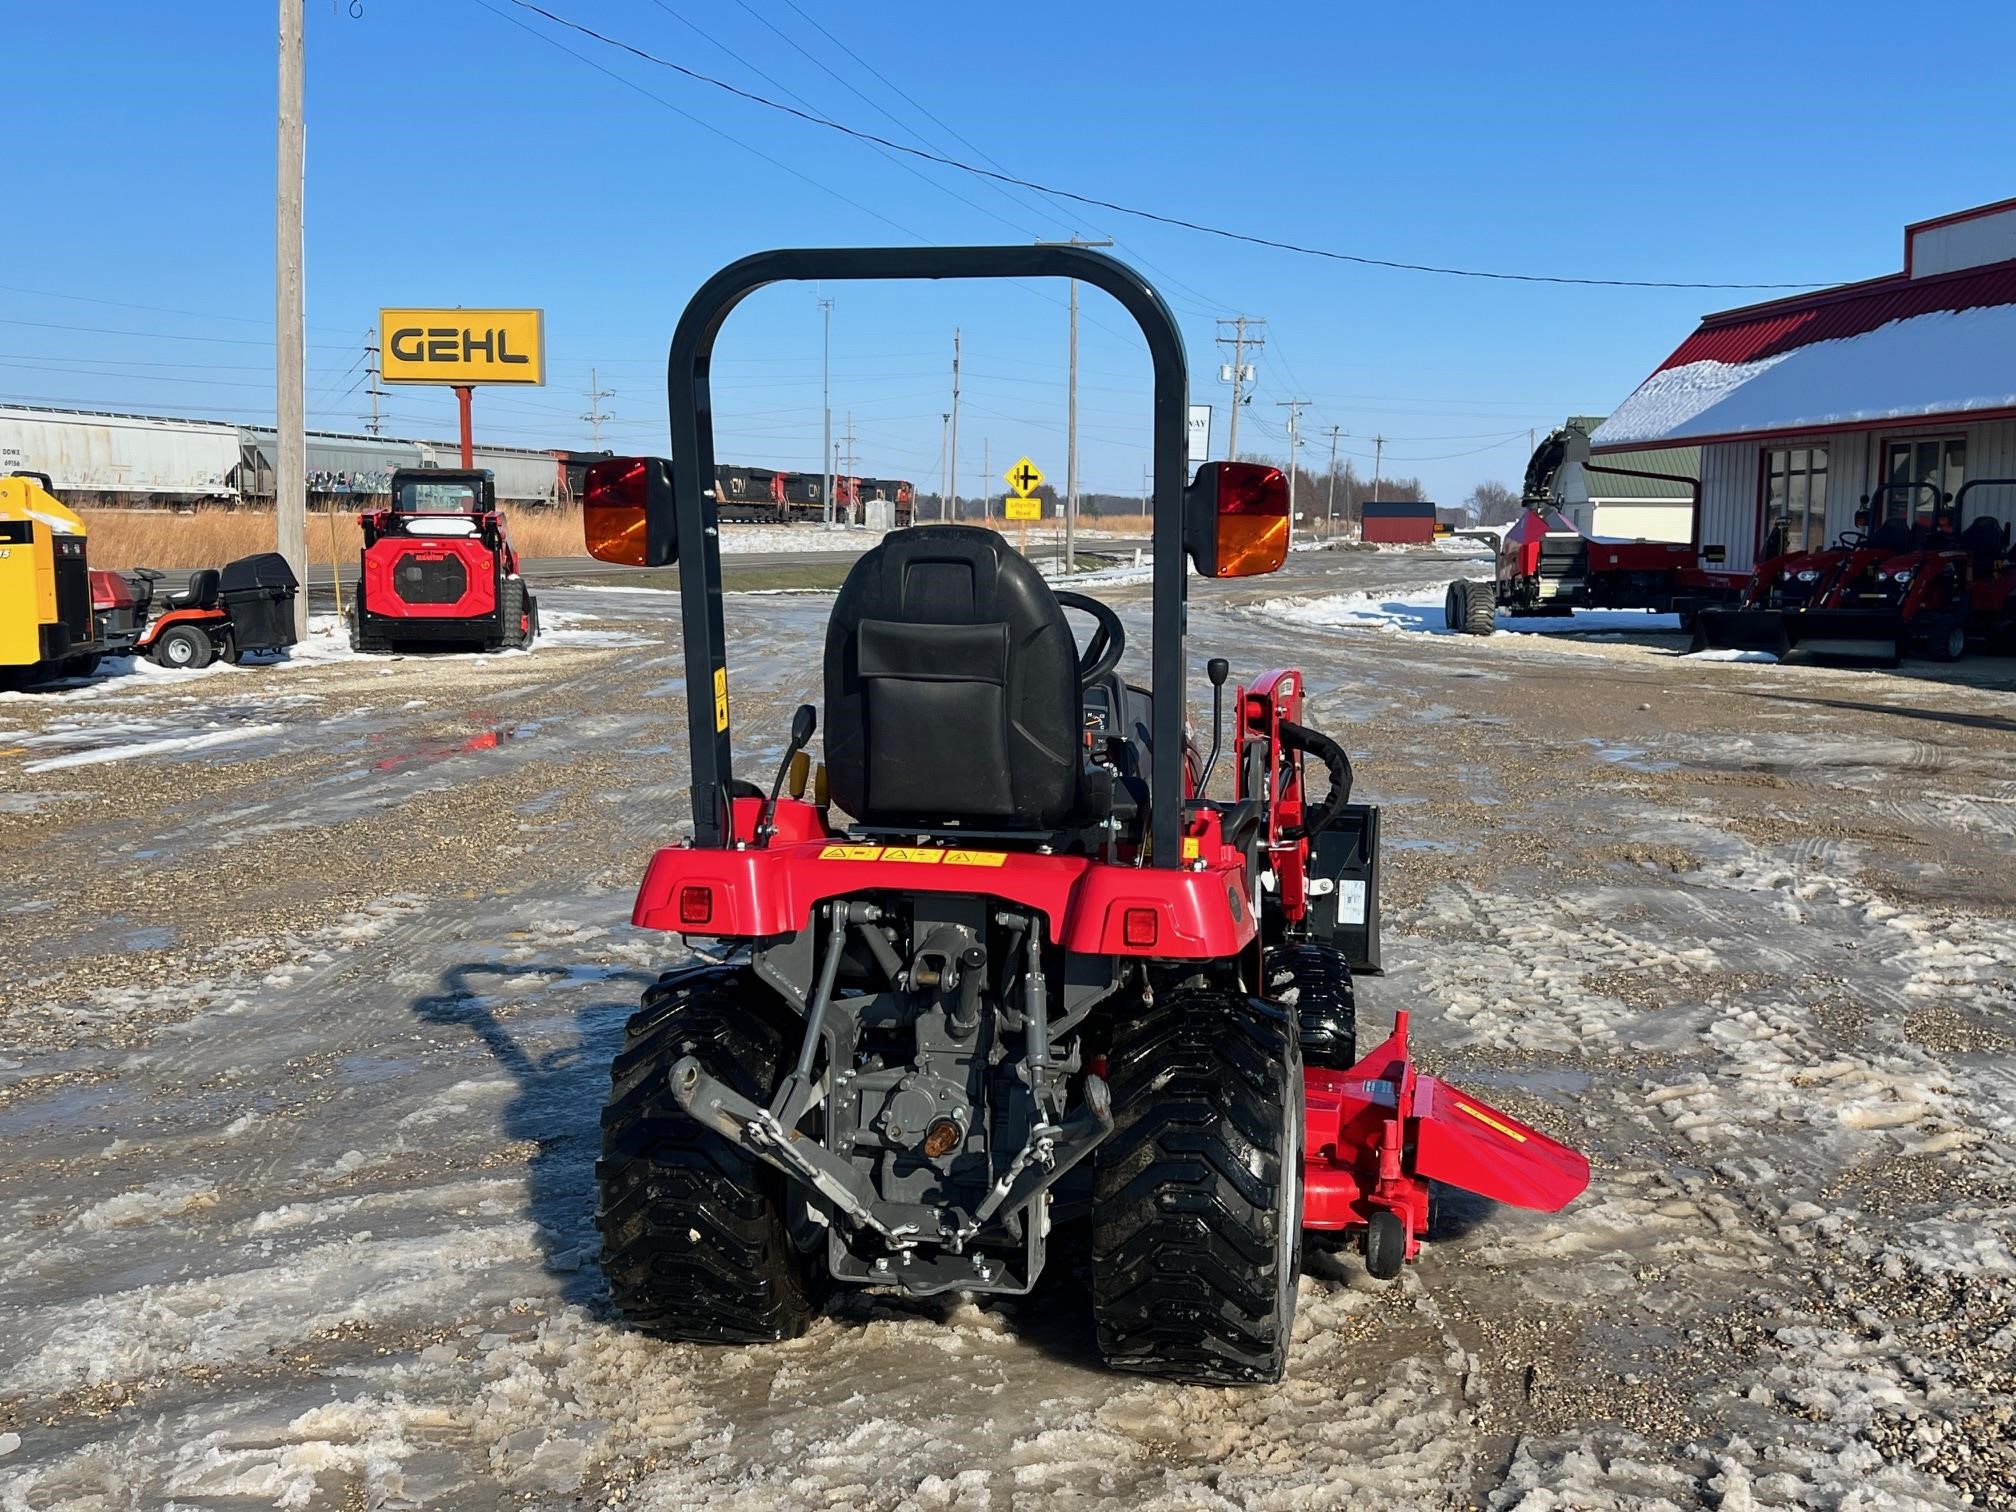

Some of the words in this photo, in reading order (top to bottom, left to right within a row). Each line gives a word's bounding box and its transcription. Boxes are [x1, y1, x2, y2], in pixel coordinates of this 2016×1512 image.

[390, 328, 530, 363] GEHL
[730, 478, 746, 494] CN
[809, 484, 820, 498] CN
